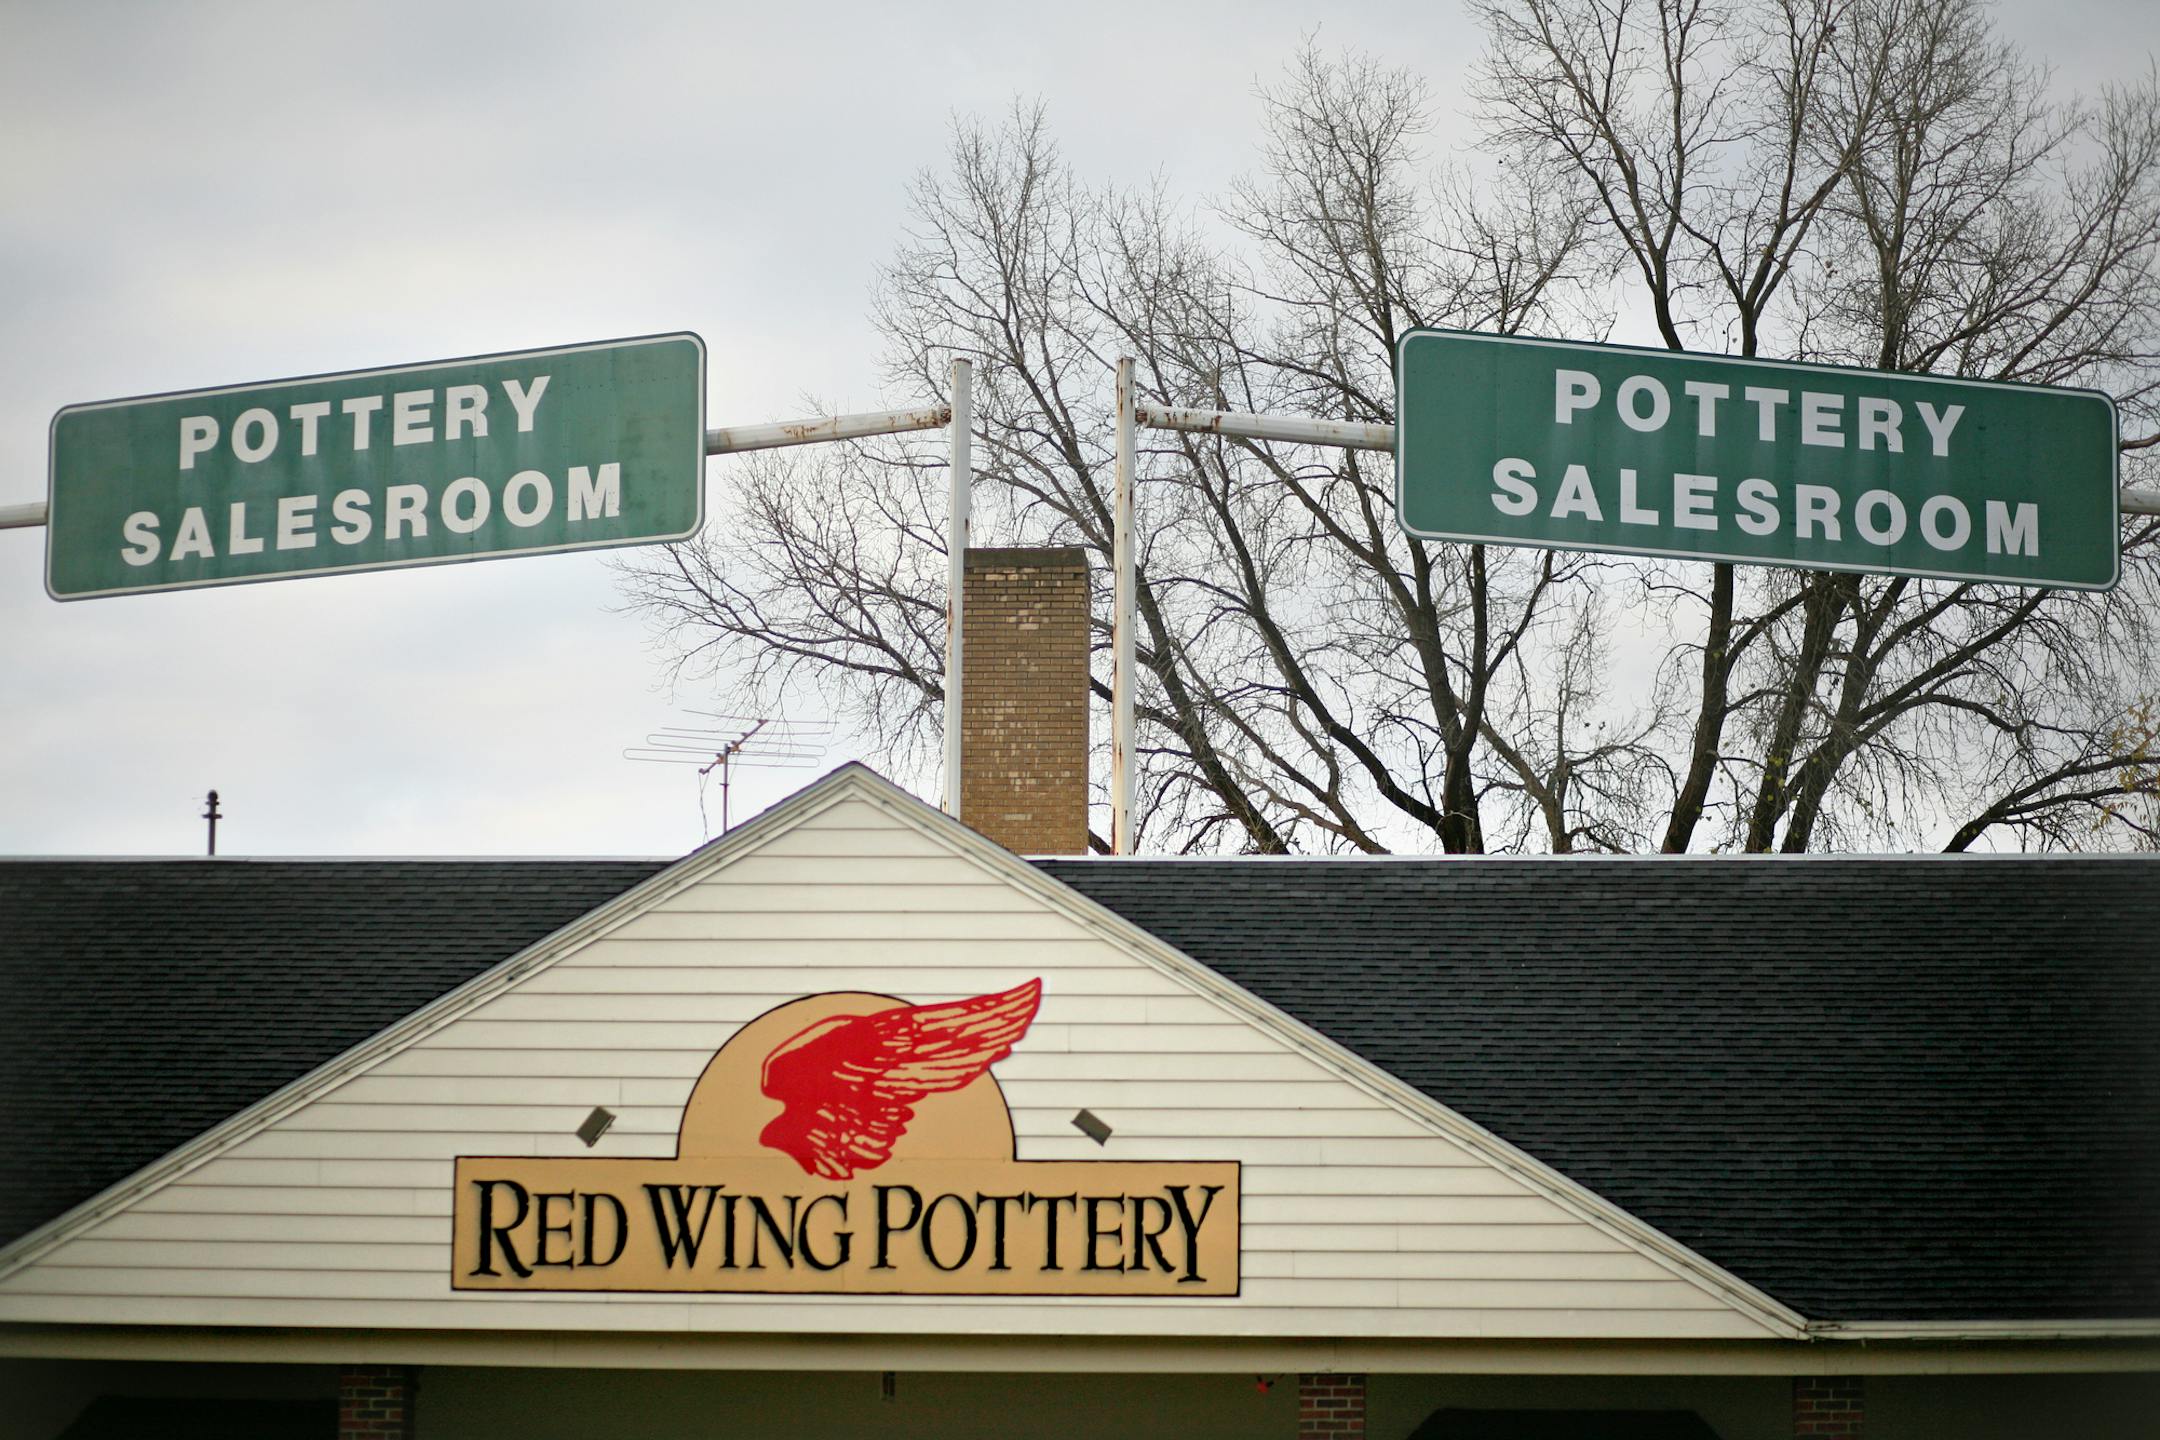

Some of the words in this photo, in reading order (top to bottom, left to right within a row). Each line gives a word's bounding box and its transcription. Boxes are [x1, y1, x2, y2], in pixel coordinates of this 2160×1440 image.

[179, 375, 552, 470] POTTERY
[1555, 368, 1965, 457] POTTERY
[121, 462, 622, 567] SALESROOM
[1491, 457, 2040, 557] SALESROOM
[468, 1179, 629, 1280] RED
[642, 1183, 854, 1272] WING
[869, 1184, 1225, 1284] POTTERY
